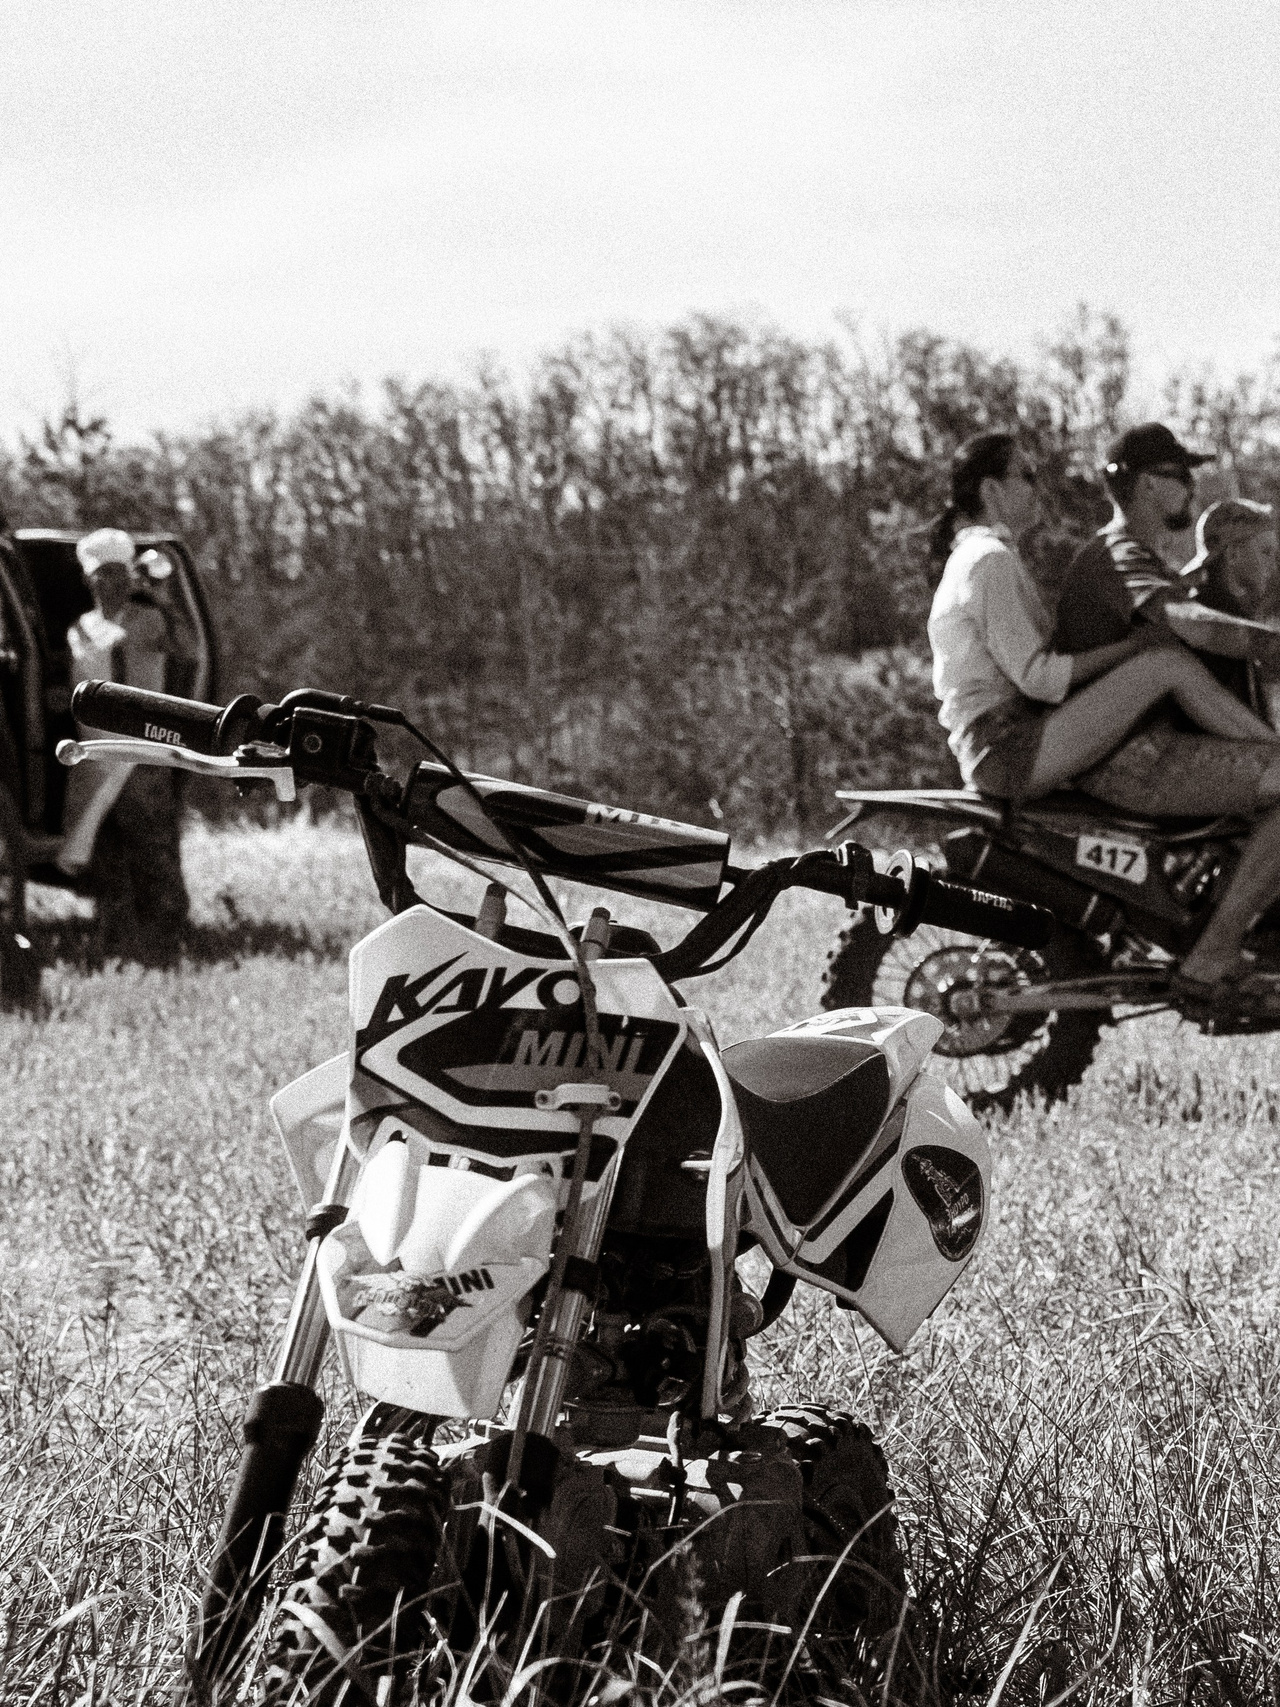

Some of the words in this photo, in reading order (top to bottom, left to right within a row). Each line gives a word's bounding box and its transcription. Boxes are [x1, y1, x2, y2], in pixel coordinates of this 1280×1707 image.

[1086, 844, 1139, 874] 417
[362, 950, 595, 1029] KAYO
[512, 1030, 645, 1074] MINI
